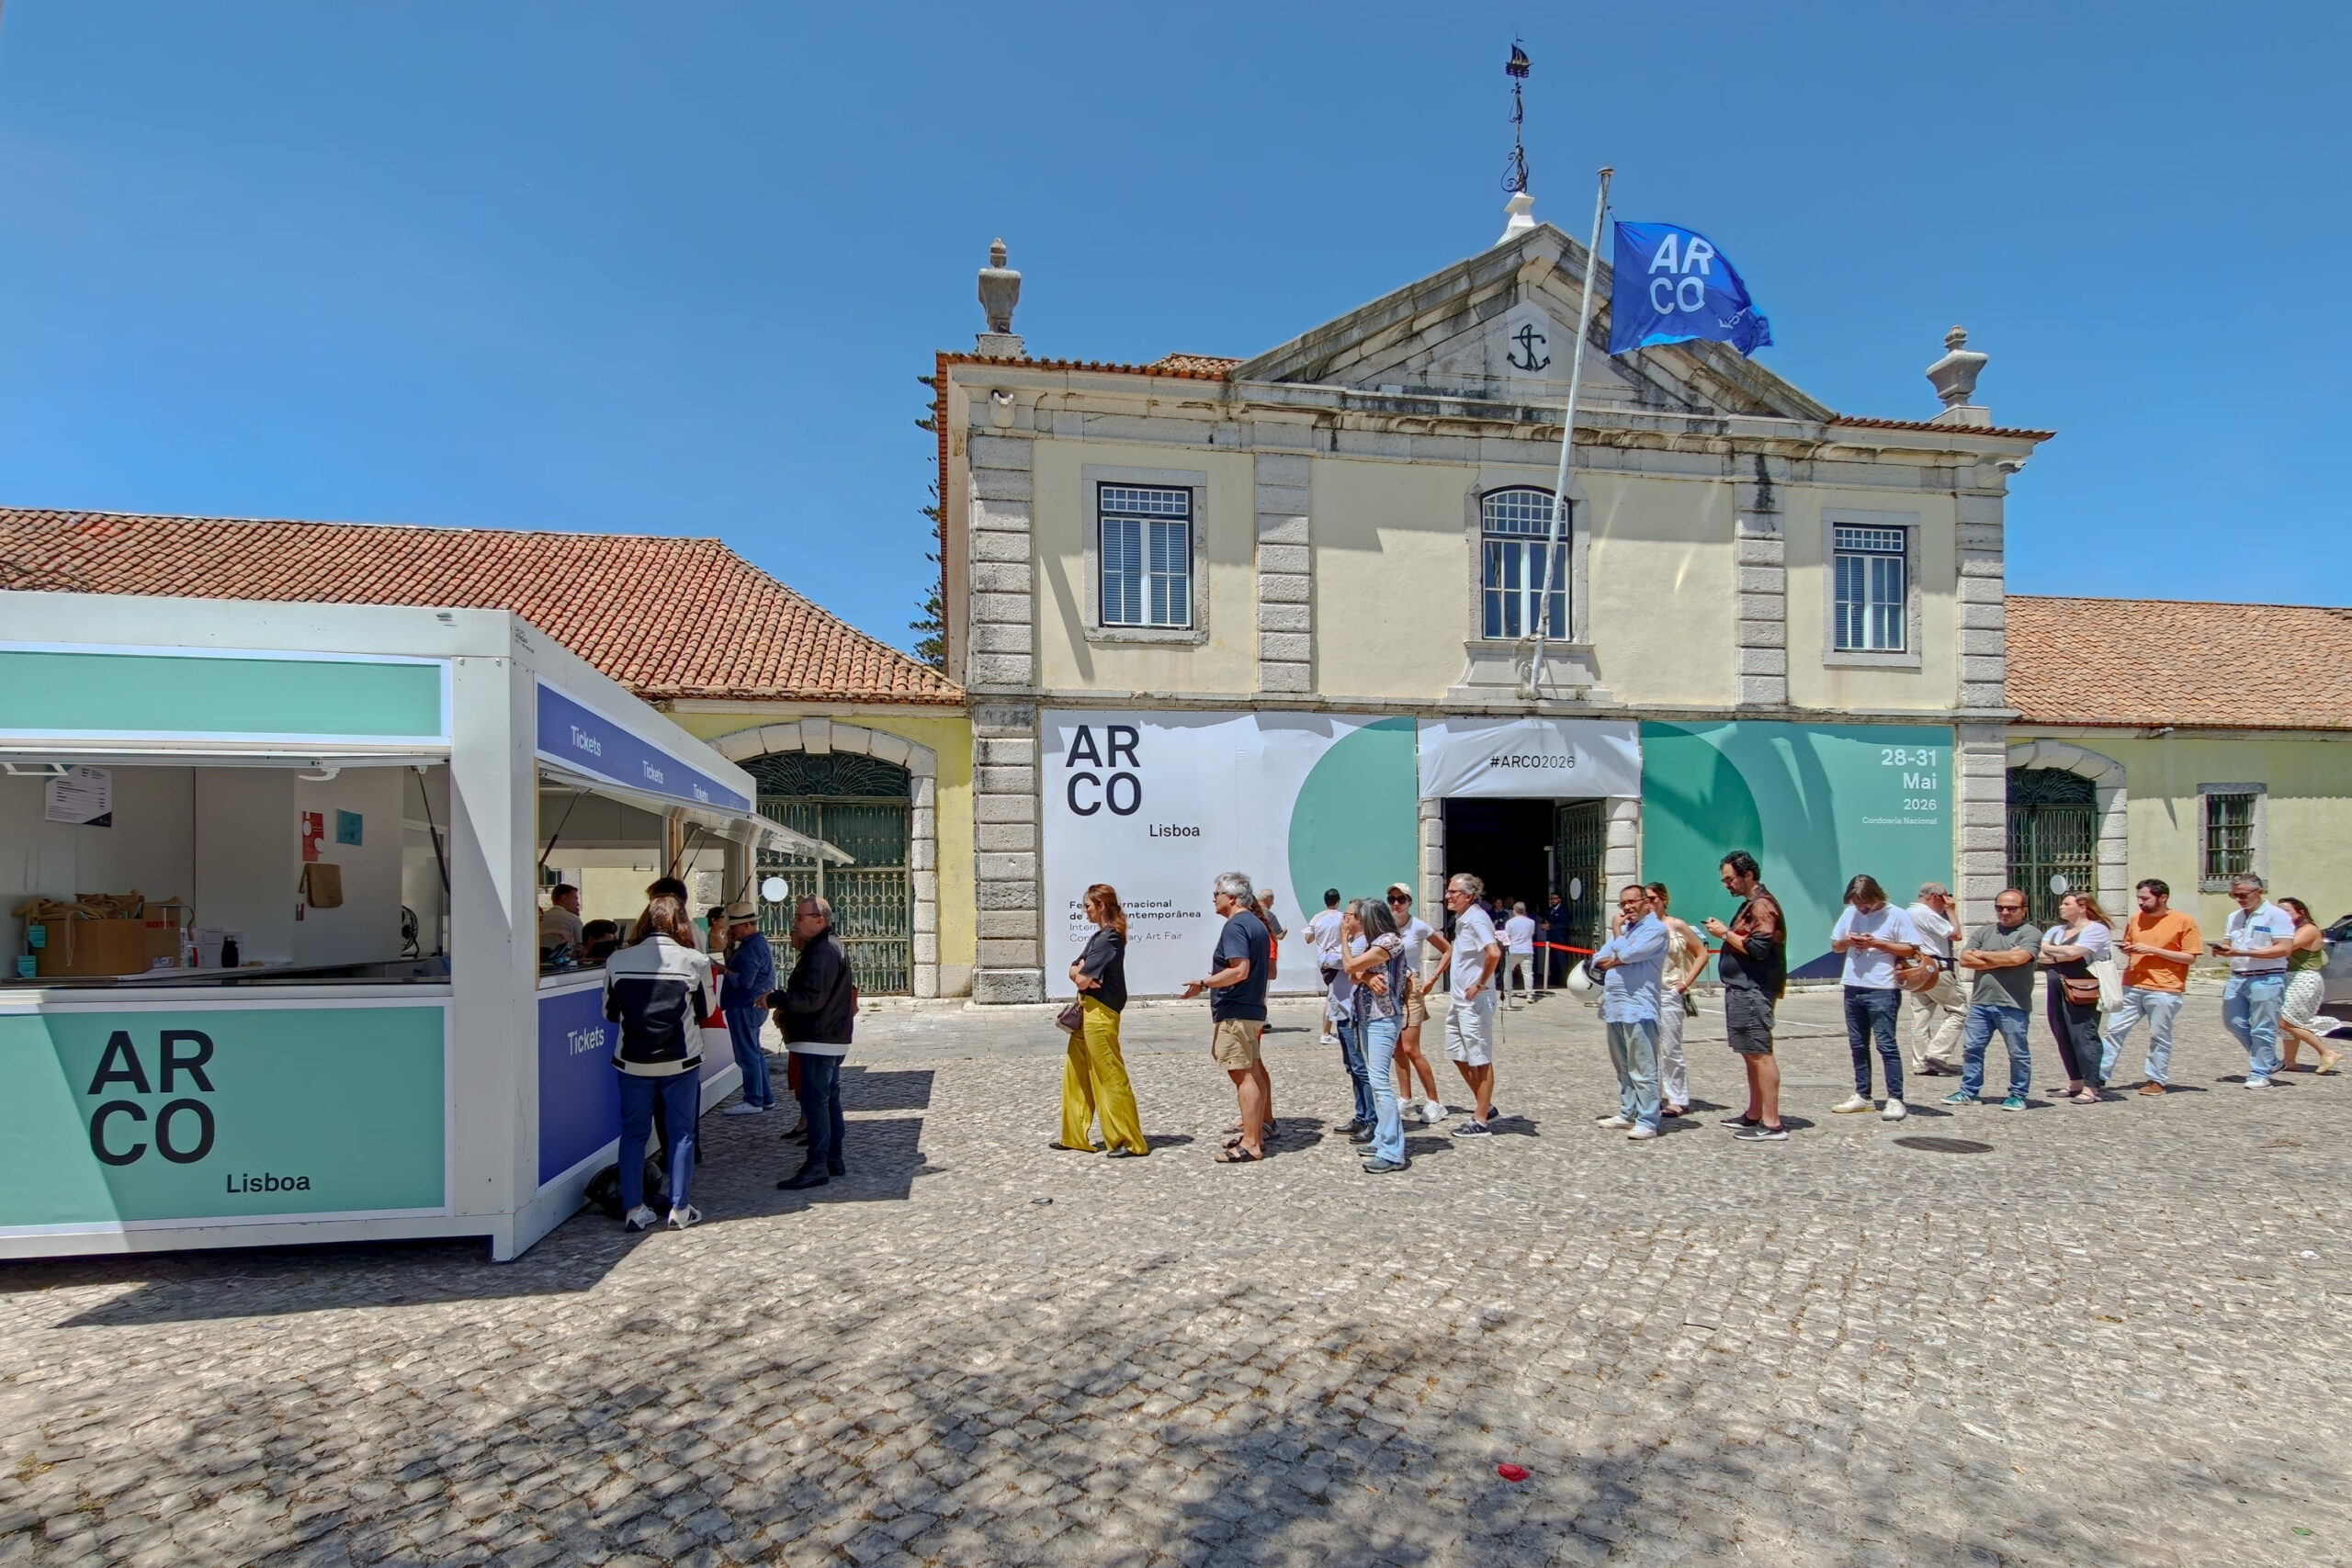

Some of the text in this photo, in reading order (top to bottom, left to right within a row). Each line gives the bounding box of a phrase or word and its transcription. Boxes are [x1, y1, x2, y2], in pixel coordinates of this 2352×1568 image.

[1647, 233, 1715, 275] AR
[1649, 276, 1705, 315] CO
[571, 725, 602, 757] Tickets
[1066, 725, 1141, 768] AR
[1489, 755, 1576, 769] #ARCO2026
[1881, 748, 1938, 767] 28-31
[642, 760, 663, 784] Tickets
[1903, 772, 1938, 790] Mai
[1067, 772, 1142, 817] CO
[1903, 798, 1938, 811] 2026
[1149, 823, 1201, 838] Lisboa
[1069, 912, 1083, 920] de
[1146, 932, 1162, 941] Art
[1164, 931, 1183, 941] Fair
[567, 1025, 605, 1056] Tickets
[86, 1029, 216, 1095] AR
[89, 1098, 216, 1167] CO
[226, 1172, 311, 1194] Lisboa
